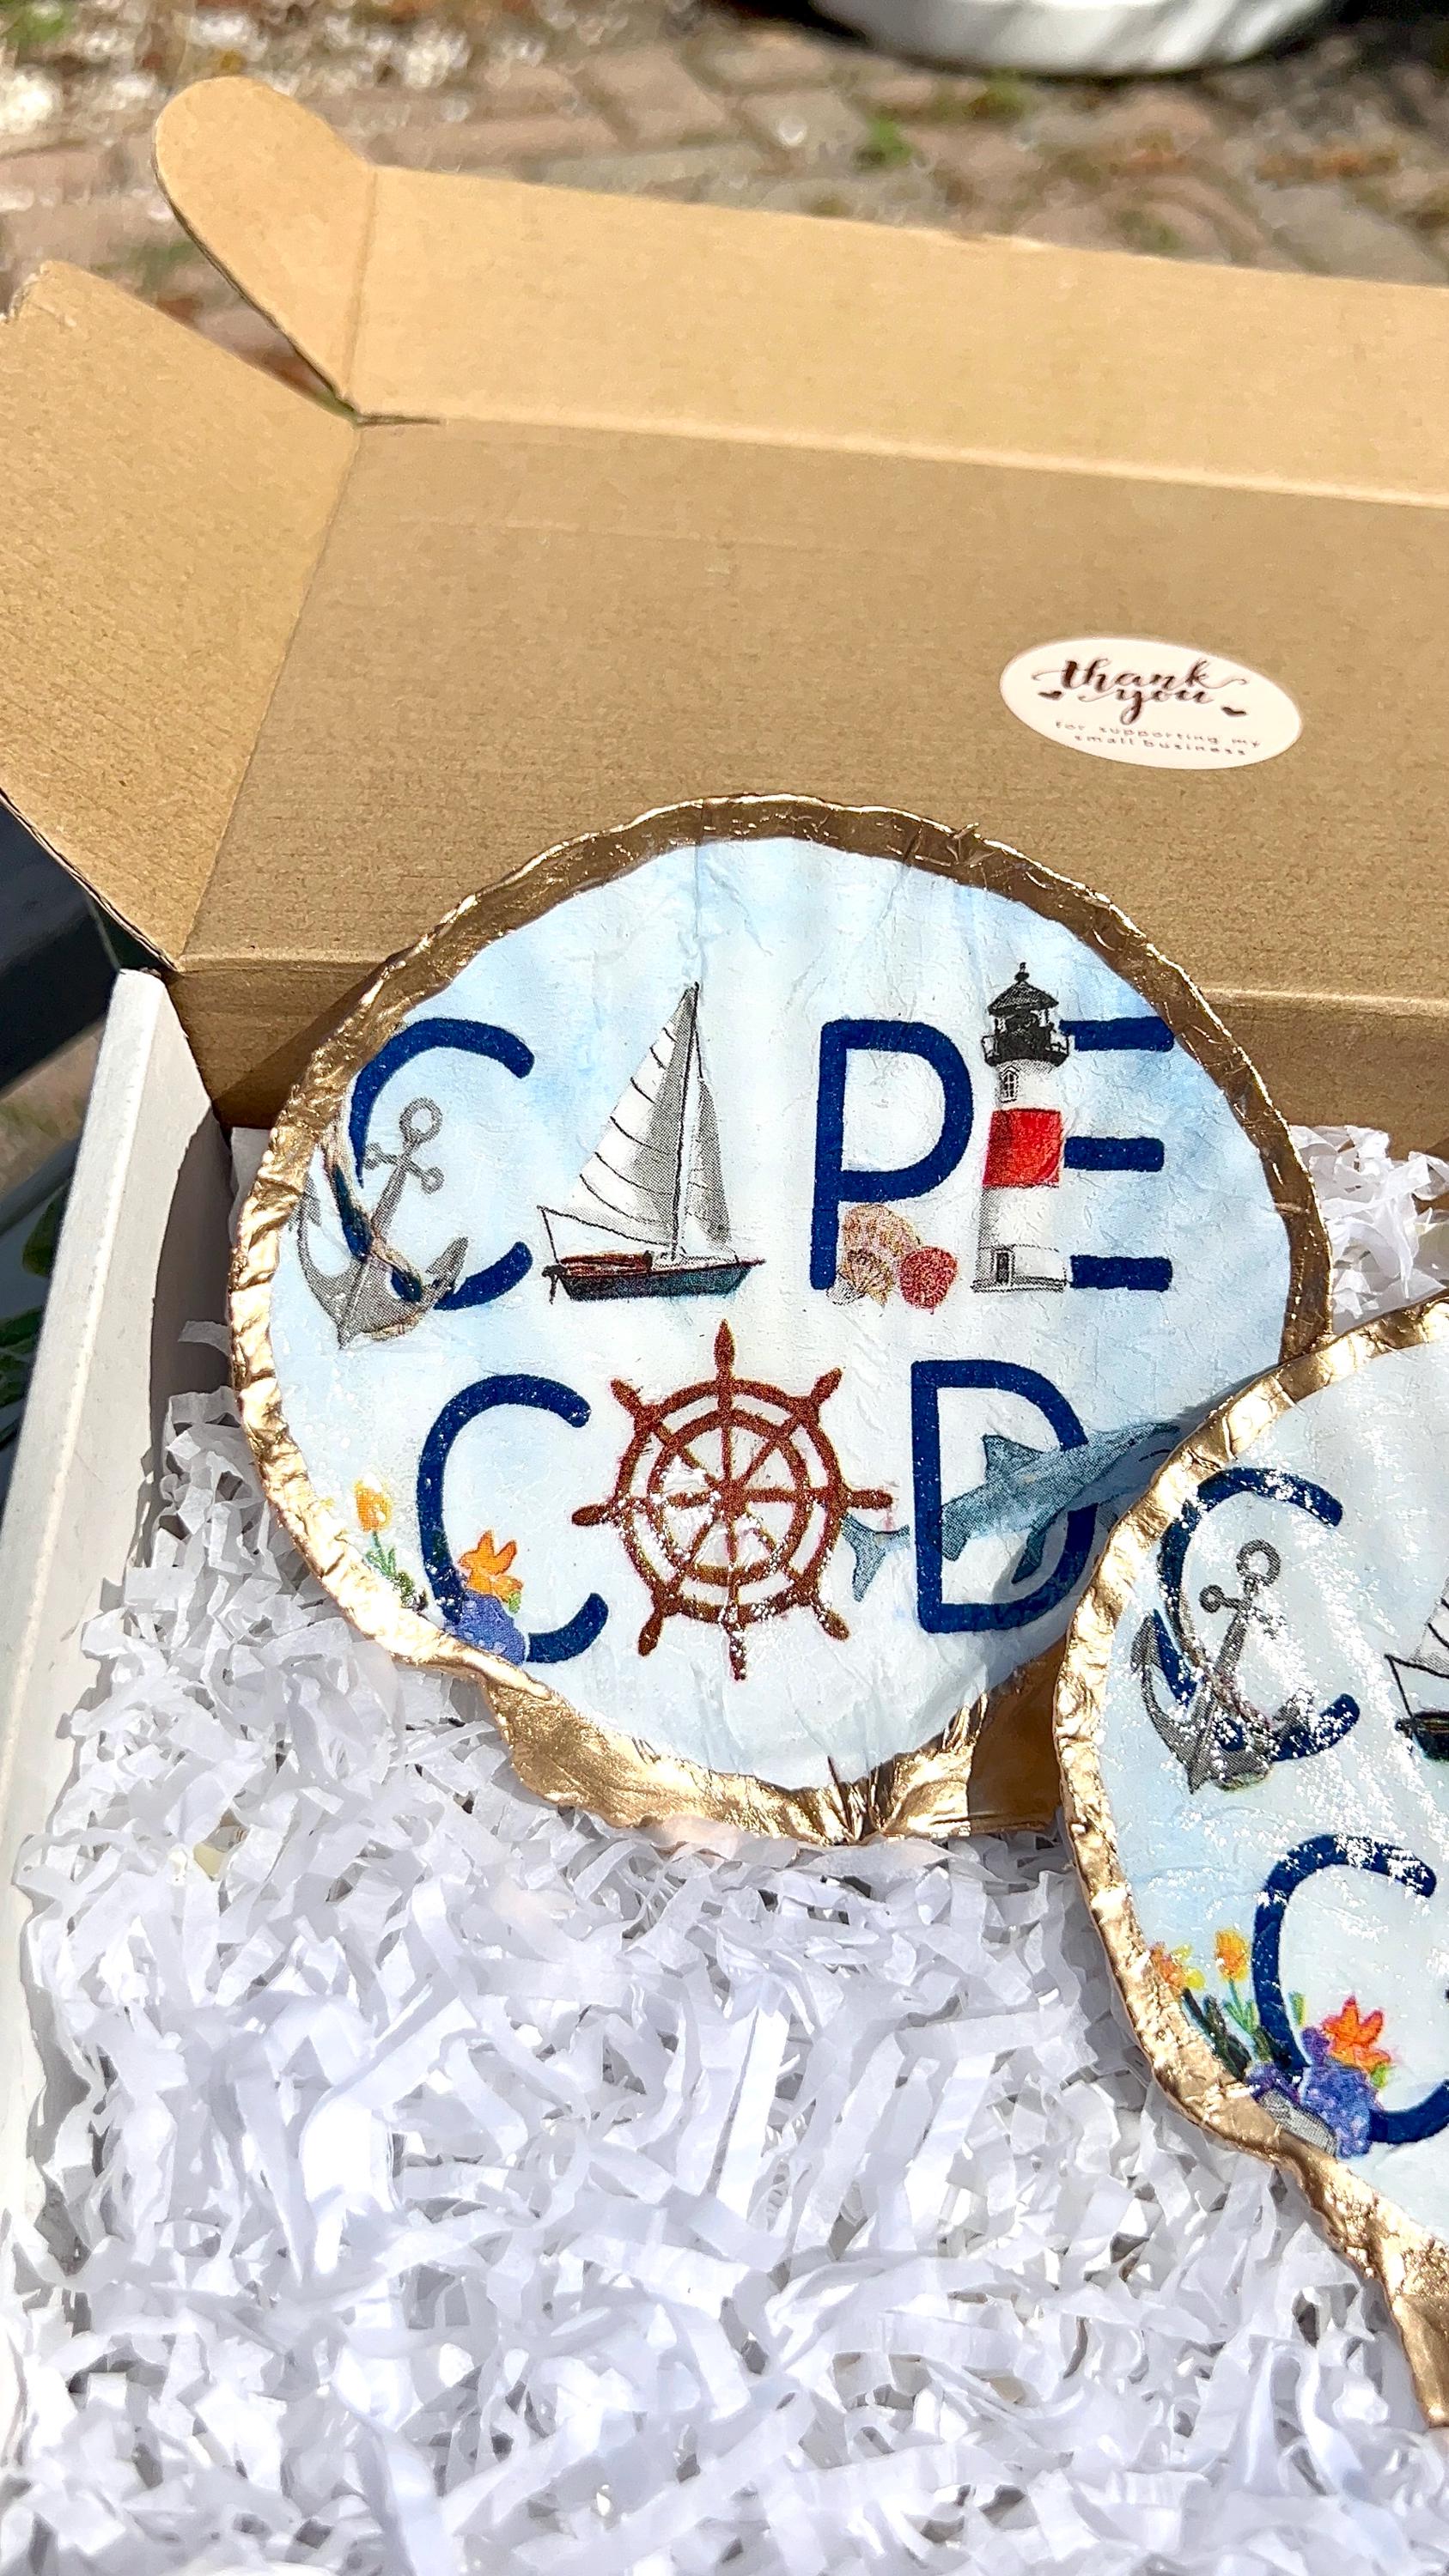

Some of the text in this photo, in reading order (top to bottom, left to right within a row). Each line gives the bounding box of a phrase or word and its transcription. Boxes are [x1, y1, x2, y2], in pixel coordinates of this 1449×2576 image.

[1032, 658, 1247, 691] thank
[1079, 688, 1214, 725] you
[1075, 734, 1245, 756] small business
[1099, 726, 1218, 744] supporting
[1232, 738, 1261, 749] my
